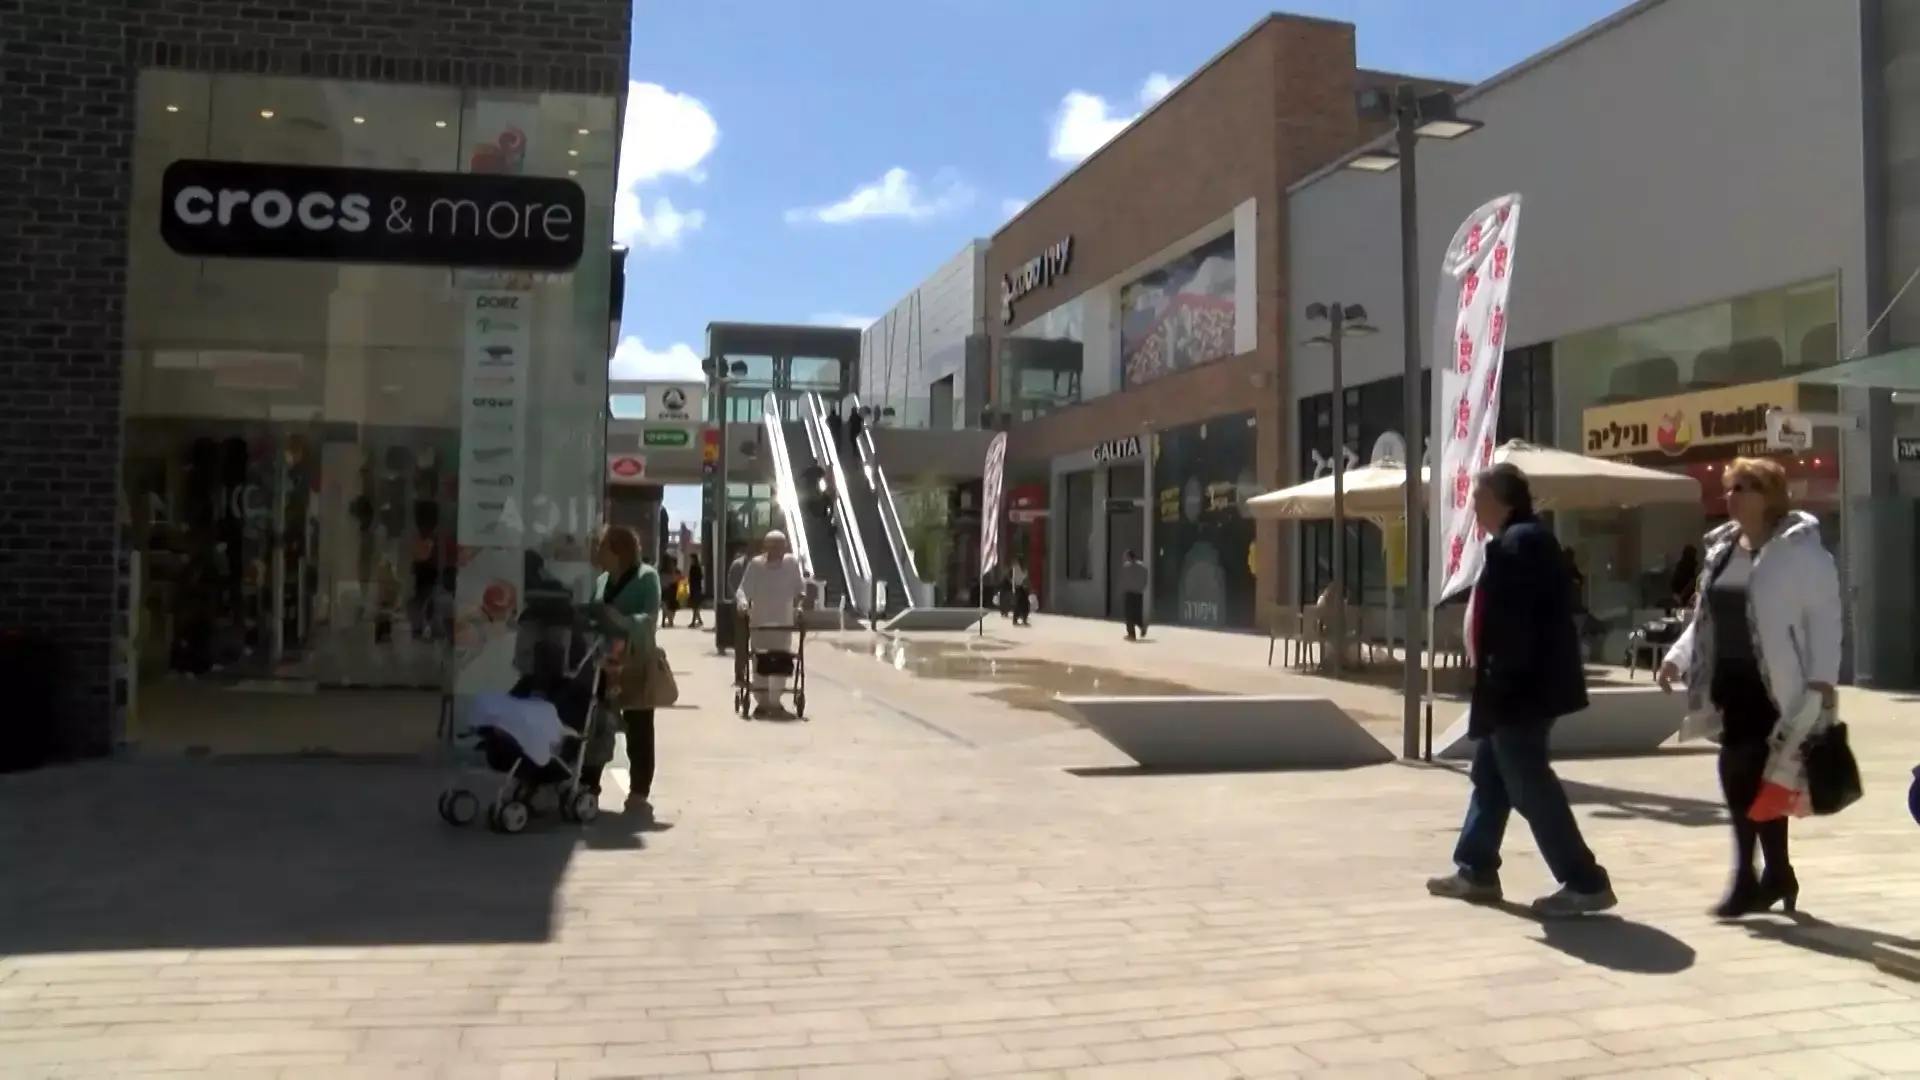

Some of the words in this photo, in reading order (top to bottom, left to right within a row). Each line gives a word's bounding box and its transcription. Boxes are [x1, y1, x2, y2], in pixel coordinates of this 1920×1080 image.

[174, 185, 371, 233] crocs
[385, 195, 413, 234] &
[428, 197, 572, 241] more
[1092, 436, 1140, 462] GALITA
[1588, 420, 1648, 452] וניליה
